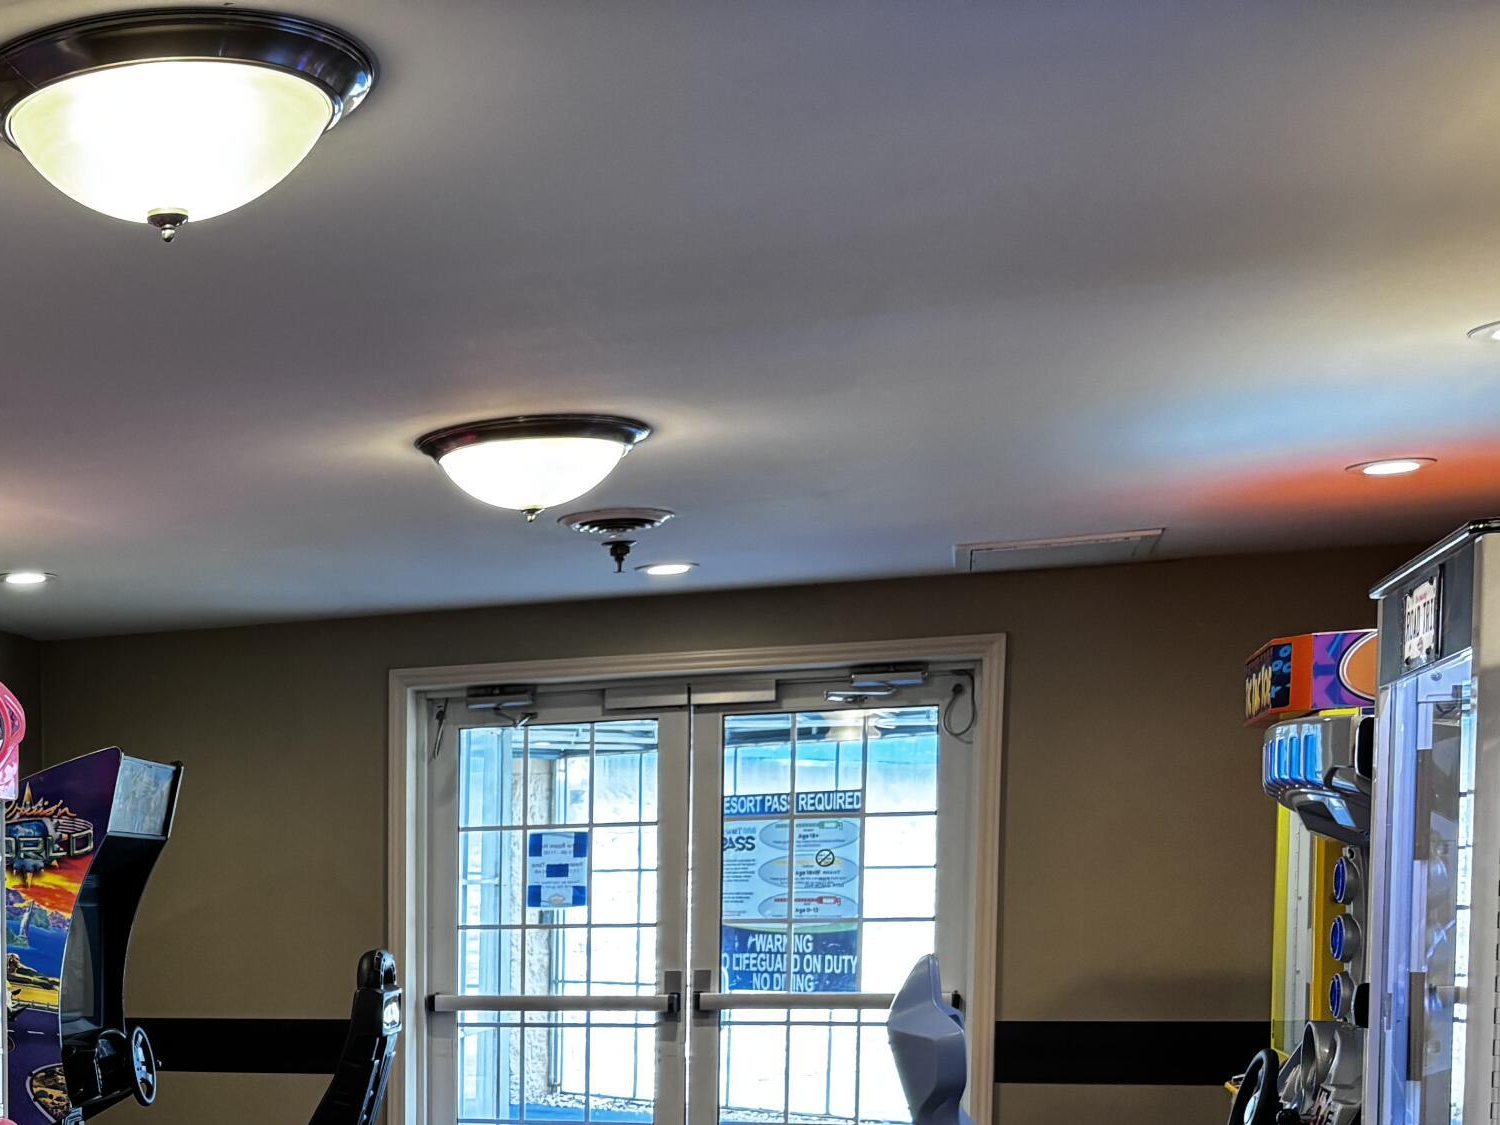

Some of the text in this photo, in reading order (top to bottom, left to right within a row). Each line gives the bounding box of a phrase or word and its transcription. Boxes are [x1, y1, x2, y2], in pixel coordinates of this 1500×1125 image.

[723, 791, 862, 814] ESORT PAS REQUIRED
[5, 829, 94, 860] RLD
[755, 934, 813, 953] WARNNG
[803, 954, 822, 973] ON
[824, 954, 858, 974] DUTY
[752, 972, 814, 992] NO DIING
